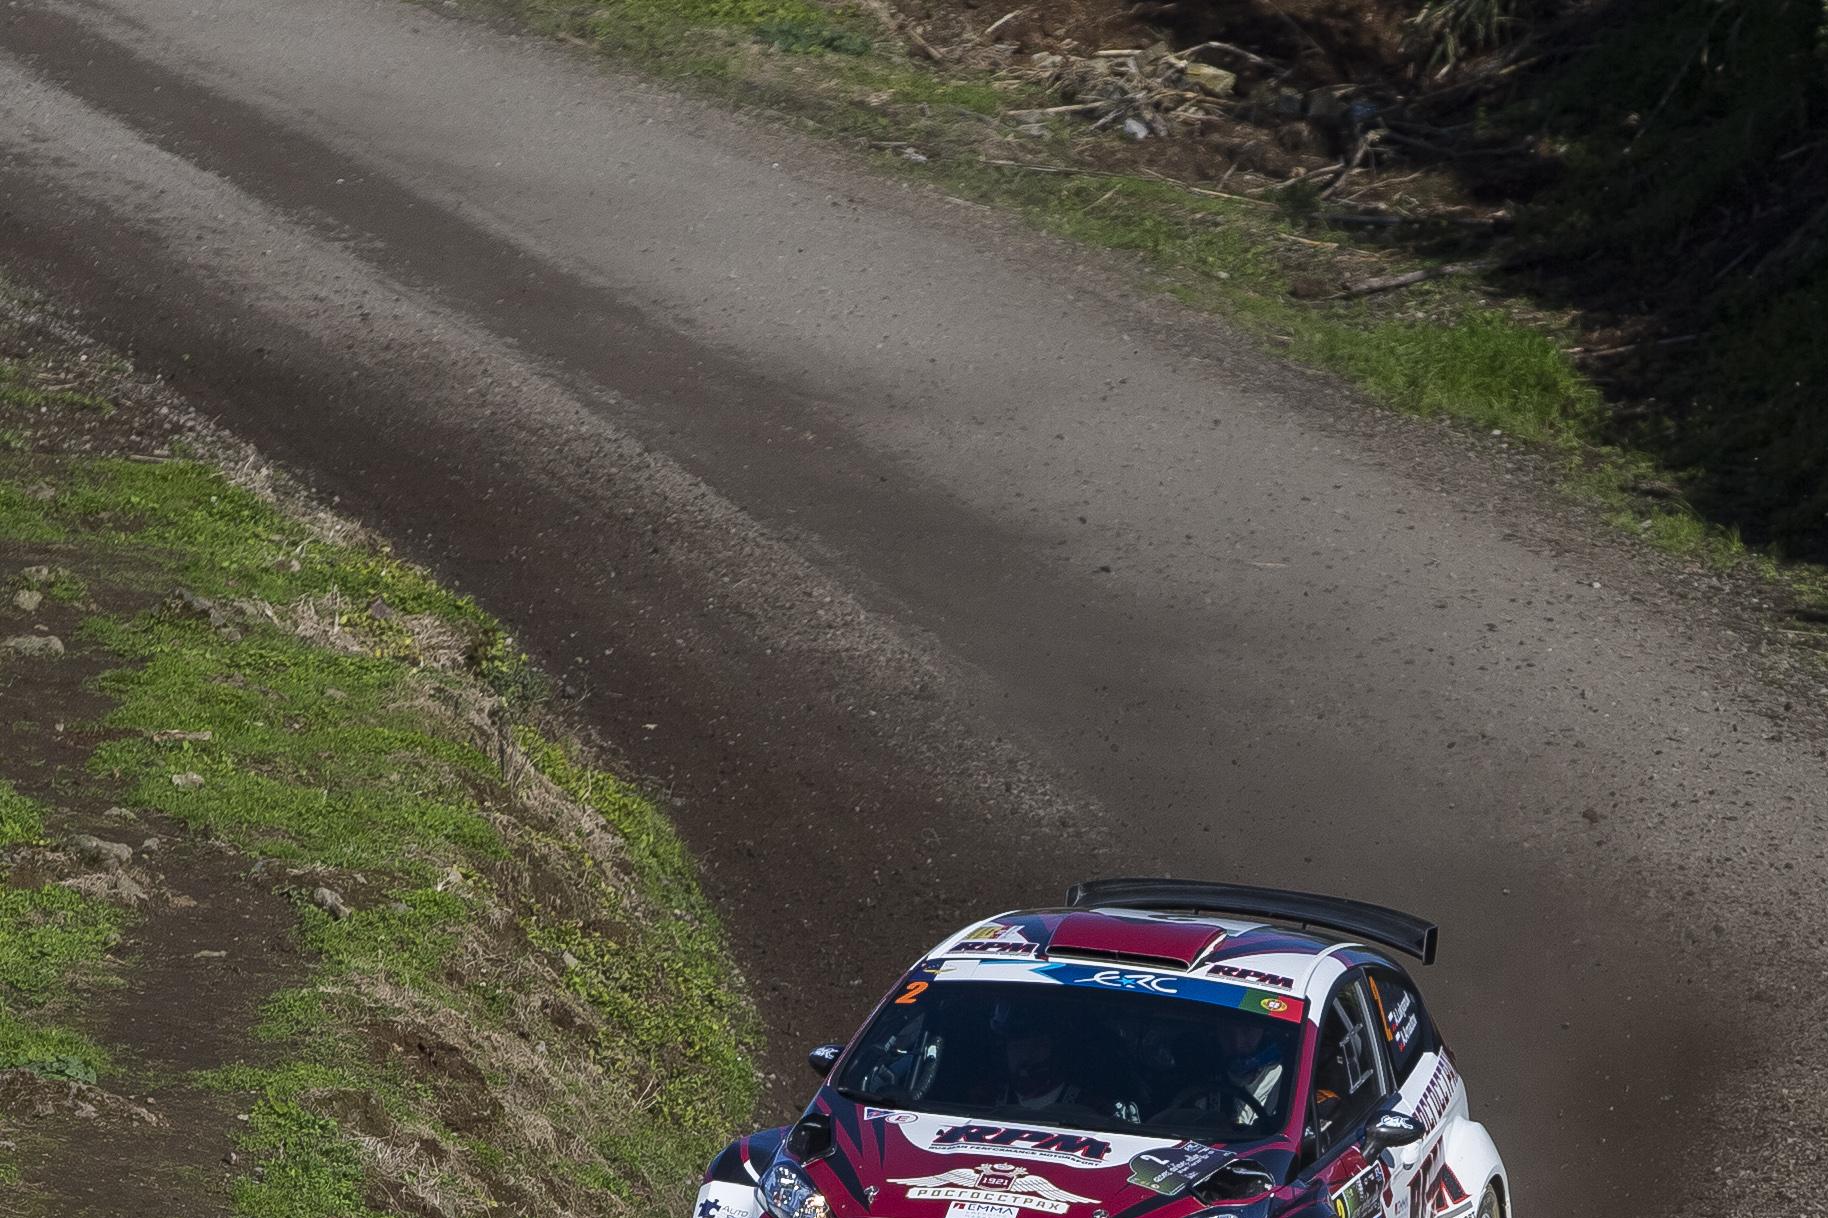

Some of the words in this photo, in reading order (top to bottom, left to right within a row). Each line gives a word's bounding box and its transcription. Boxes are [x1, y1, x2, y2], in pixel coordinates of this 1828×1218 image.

[1074, 970, 1178, 994] ERC
[1205, 964, 1295, 989] RPM
[895, 981, 929, 1004] 2
[931, 1124, 1113, 1161] RPM
[969, 1145, 1037, 1156] PERFORMANCE
[1038, 1151, 1101, 1167] MOTORSPORT
[982, 1176, 1009, 1187] 1921
[916, 1189, 1060, 1211] РОСГОССТРАХ
[967, 1203, 1014, 1216] EMMA
